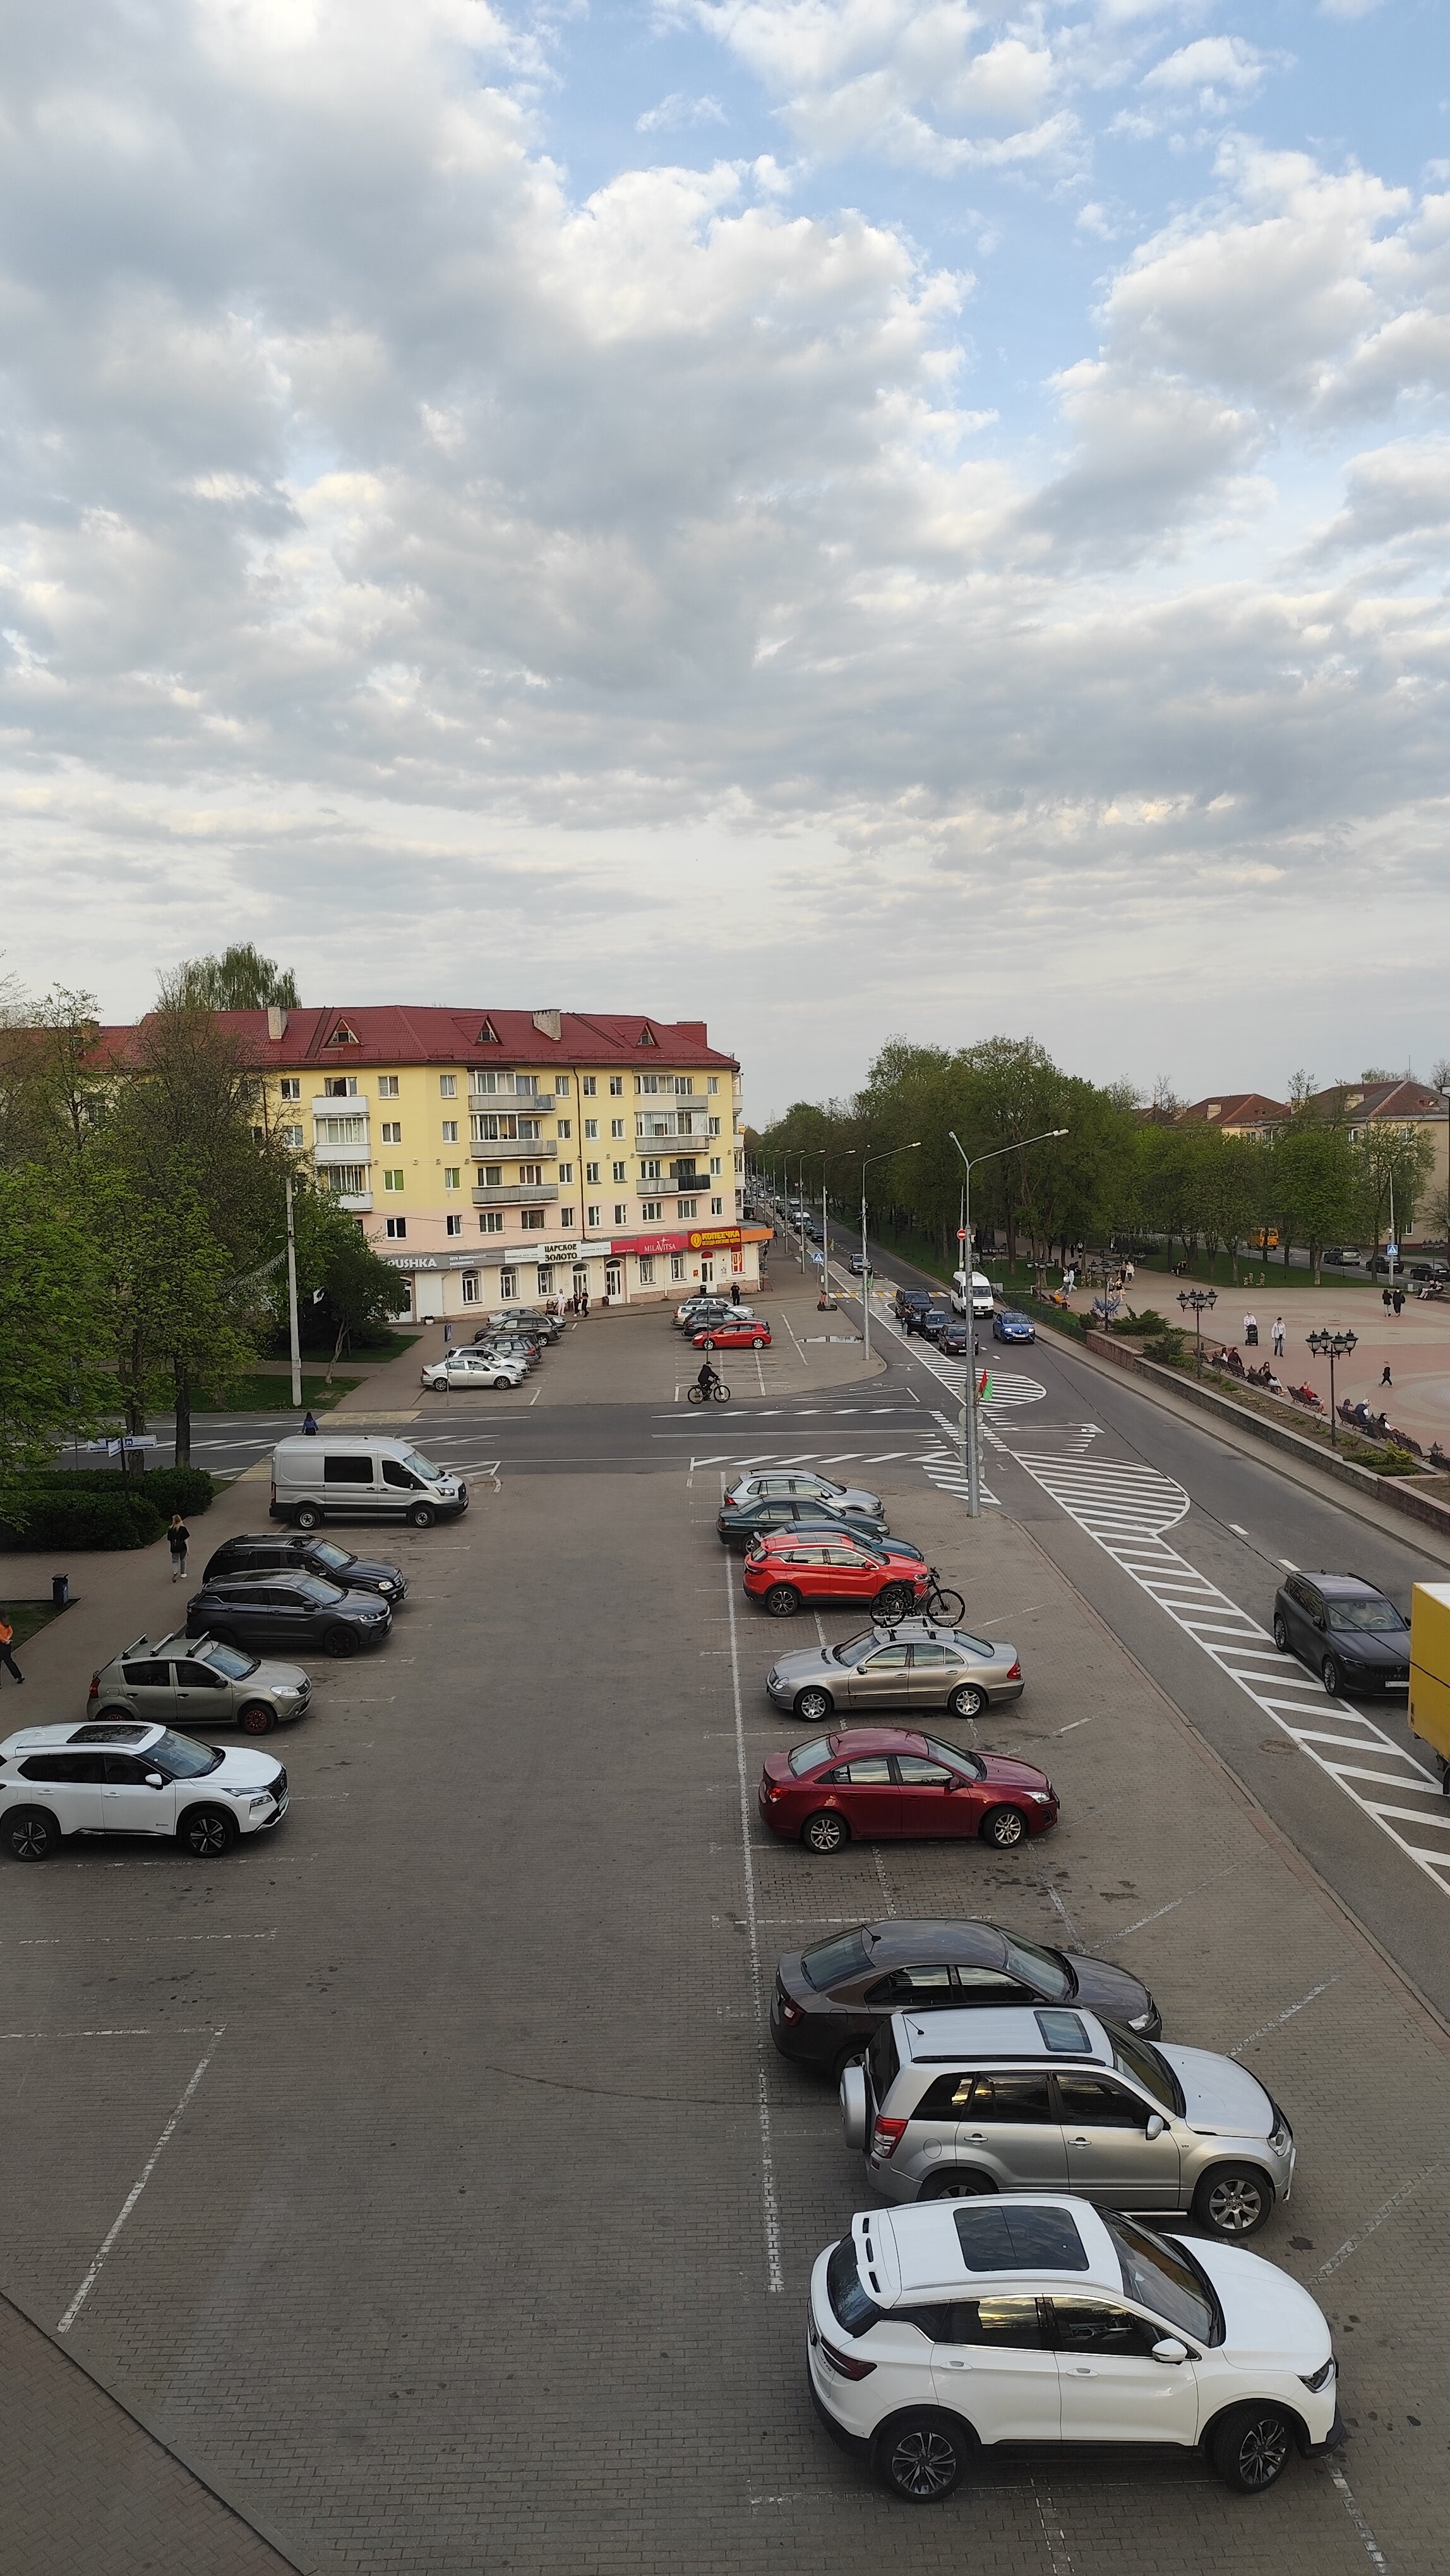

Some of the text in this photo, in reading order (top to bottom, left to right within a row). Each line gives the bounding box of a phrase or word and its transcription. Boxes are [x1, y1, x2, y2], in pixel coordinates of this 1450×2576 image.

[702, 1231, 740, 1241] КОПЕЕЧКА
[544, 1243, 577, 1253] ЦАРСКОЕ
[544, 1252, 577, 1262] ЗОЛОТО
